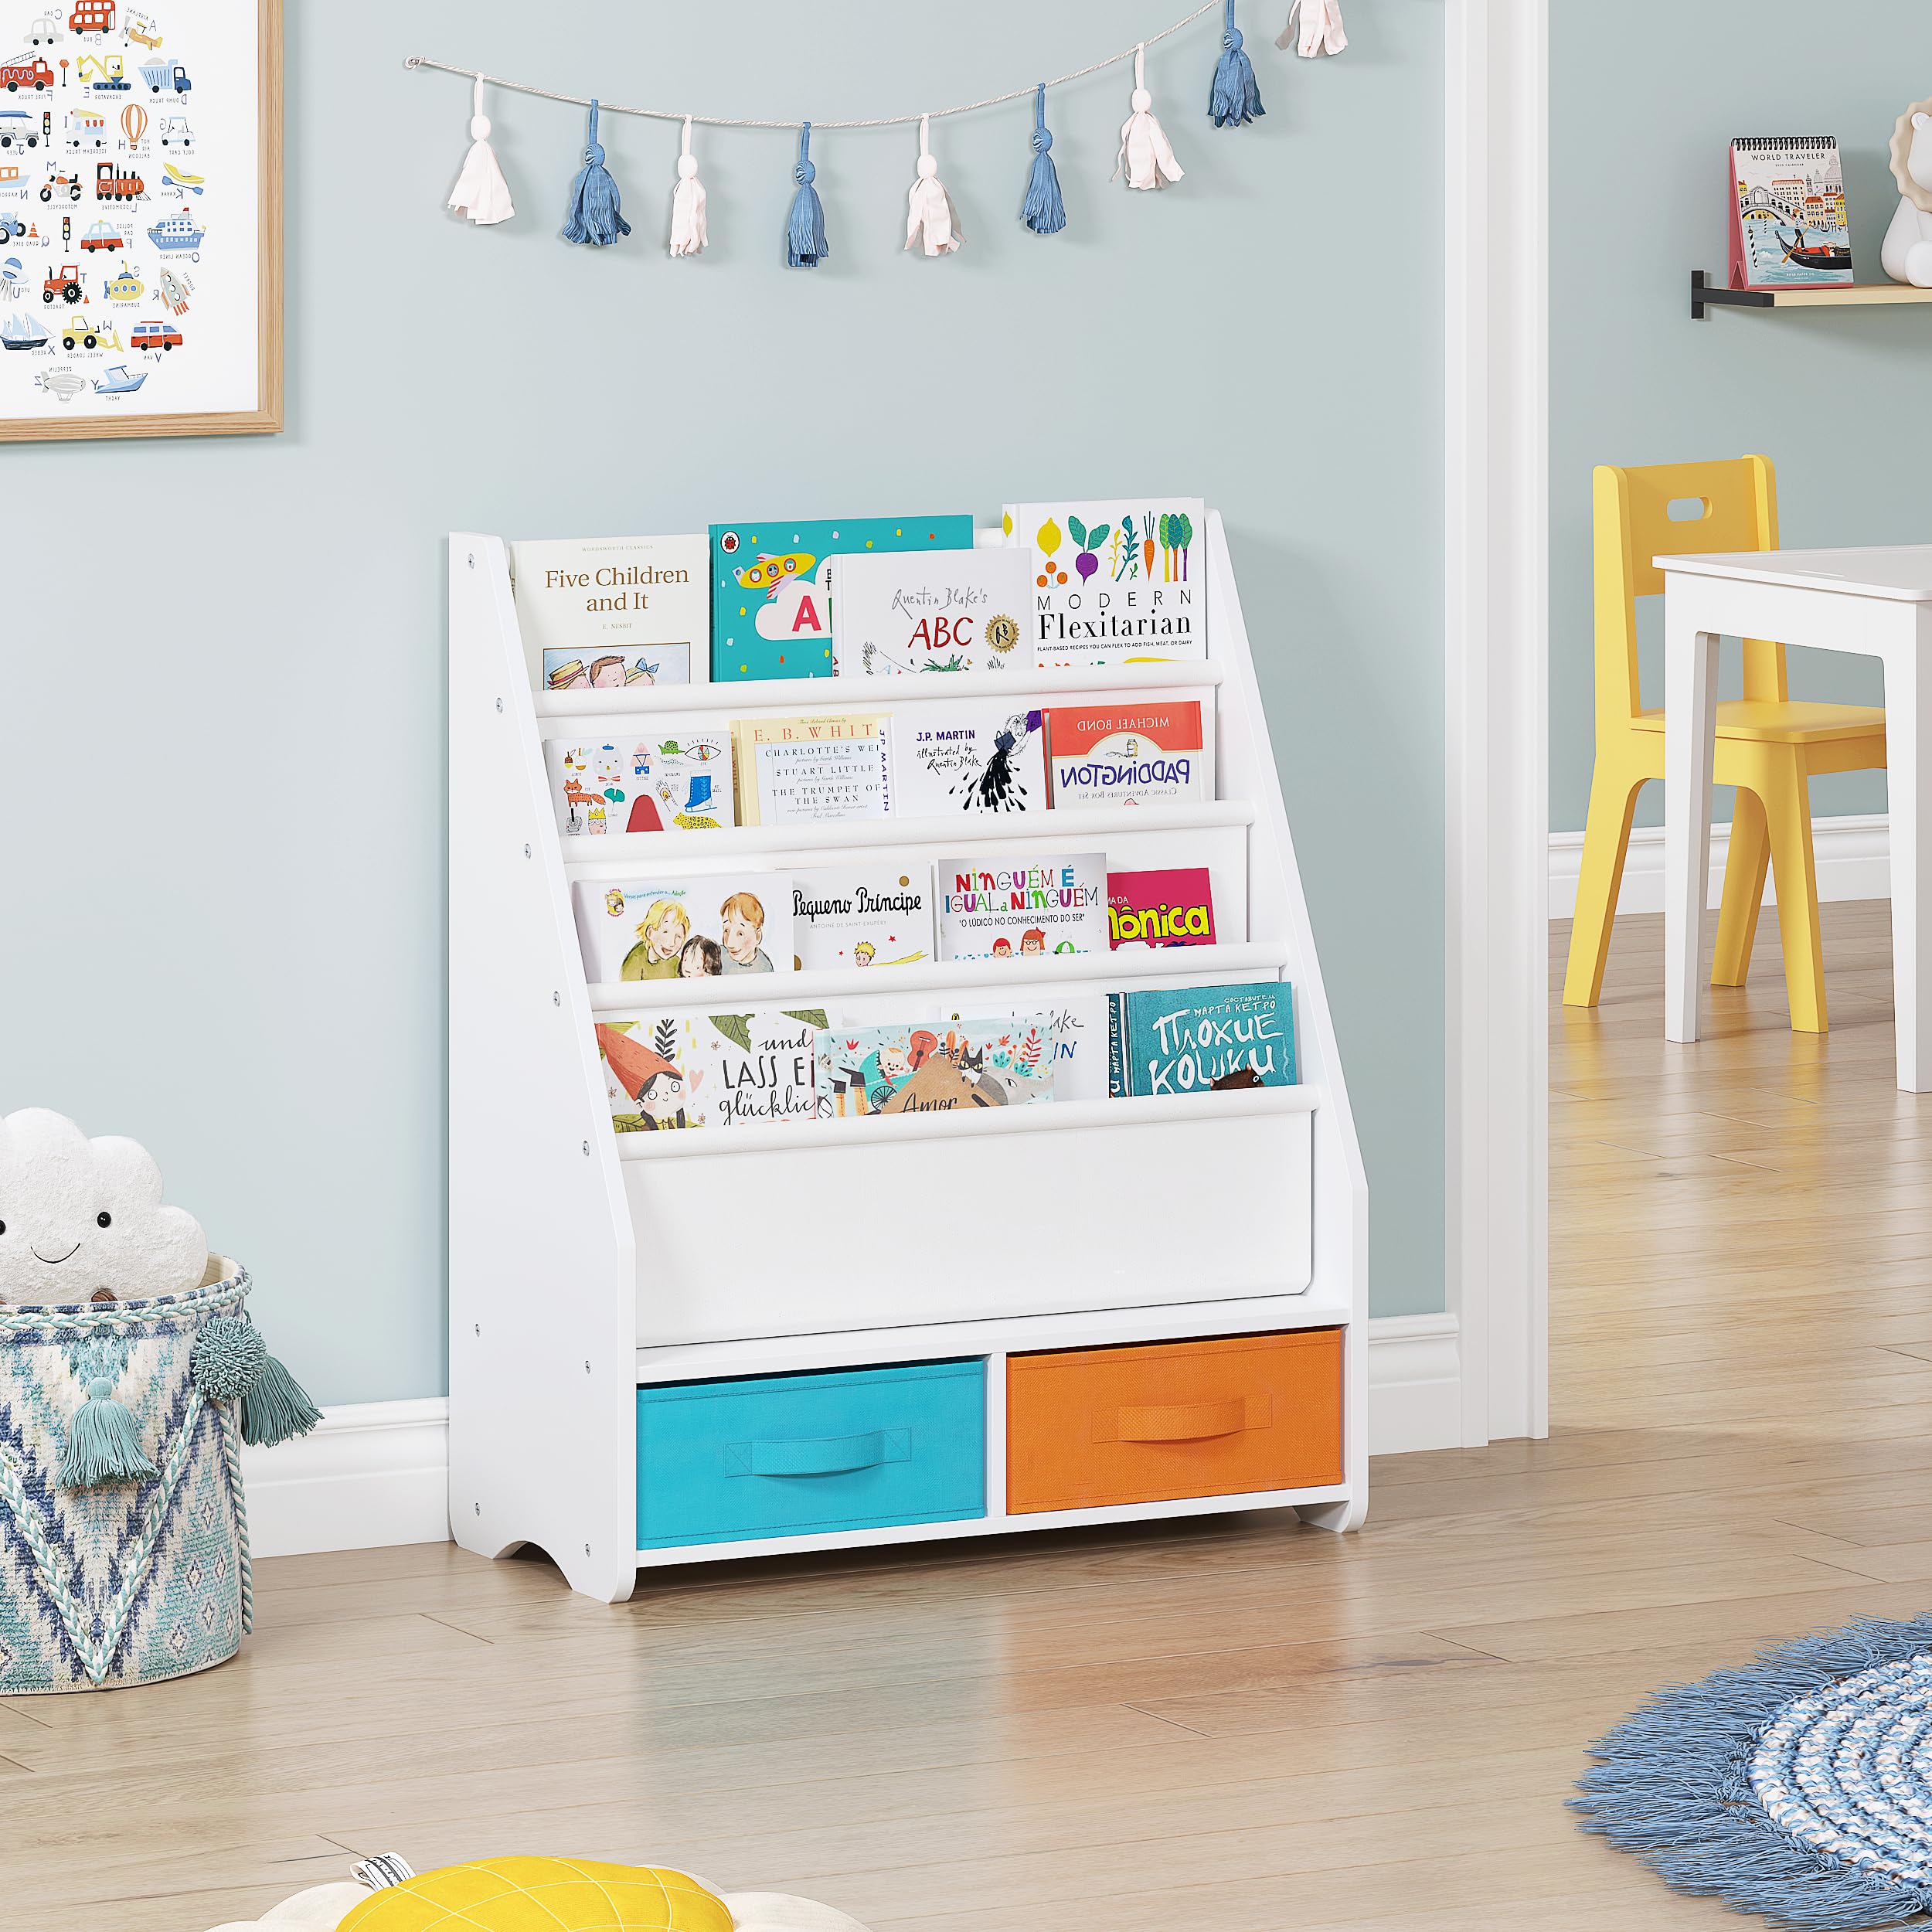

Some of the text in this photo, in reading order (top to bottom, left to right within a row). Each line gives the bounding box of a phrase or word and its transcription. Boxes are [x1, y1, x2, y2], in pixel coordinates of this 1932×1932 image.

[545, 566, 689, 588] Five Children
[587, 592, 648, 611] and It
[892, 587, 988, 619] Quentin Blake's
[1037, 589, 1192, 611] MODERN
[908, 617, 974, 650] ABC
[1038, 609, 1192, 640] Flexitarian
[754, 723, 872, 742] E. B. WHIT
[916, 730, 975, 742] J.P. MARTIN
[765, 746, 850, 757] CHARLOTTE'S
[964, 743, 977, 755] by
[776, 764, 874, 777] STUART LITTLE
[927, 758, 957, 775] Quentin
[801, 785, 859, 794] TRUMPET
[825, 794, 859, 804] SWAN
[1062, 865, 1074, 886] É
[793, 887, 921, 923] Pequeno Príncipe
[946, 893, 998, 913] IGUAL
[1001, 902, 1008, 911] a
[969, 916, 993, 927] LÚDICO
[1007, 915, 1058, 925] CONHECIMENTO
[1060, 914, 1070, 923] DO
[1236, 1000, 1275, 1012] КЕТРО
[757, 1029, 813, 1051] und
[723, 1056, 777, 1089] LASS
[719, 1085, 816, 1125] glücklic
